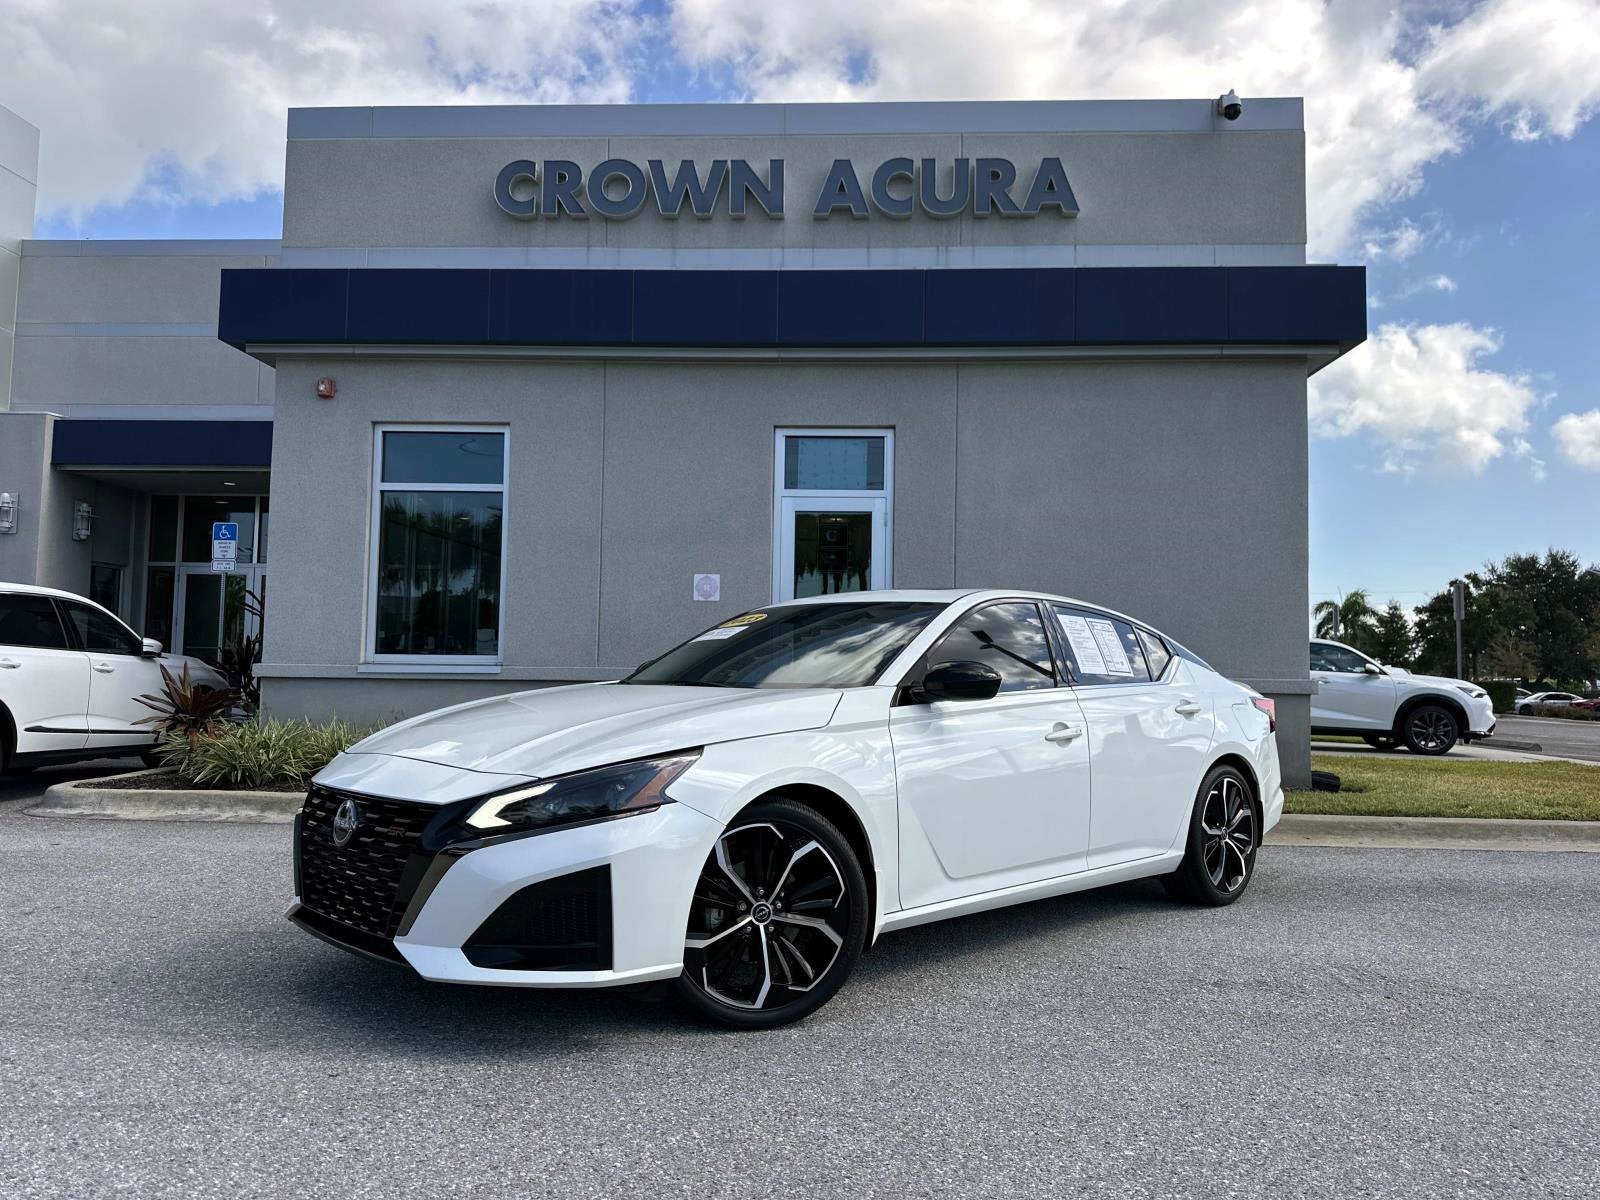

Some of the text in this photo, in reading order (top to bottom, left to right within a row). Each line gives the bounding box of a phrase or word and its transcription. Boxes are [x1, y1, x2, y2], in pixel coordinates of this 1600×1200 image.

[494, 157, 1080, 219] CROWN ACURA
[335, 817, 357, 830] SSAN
